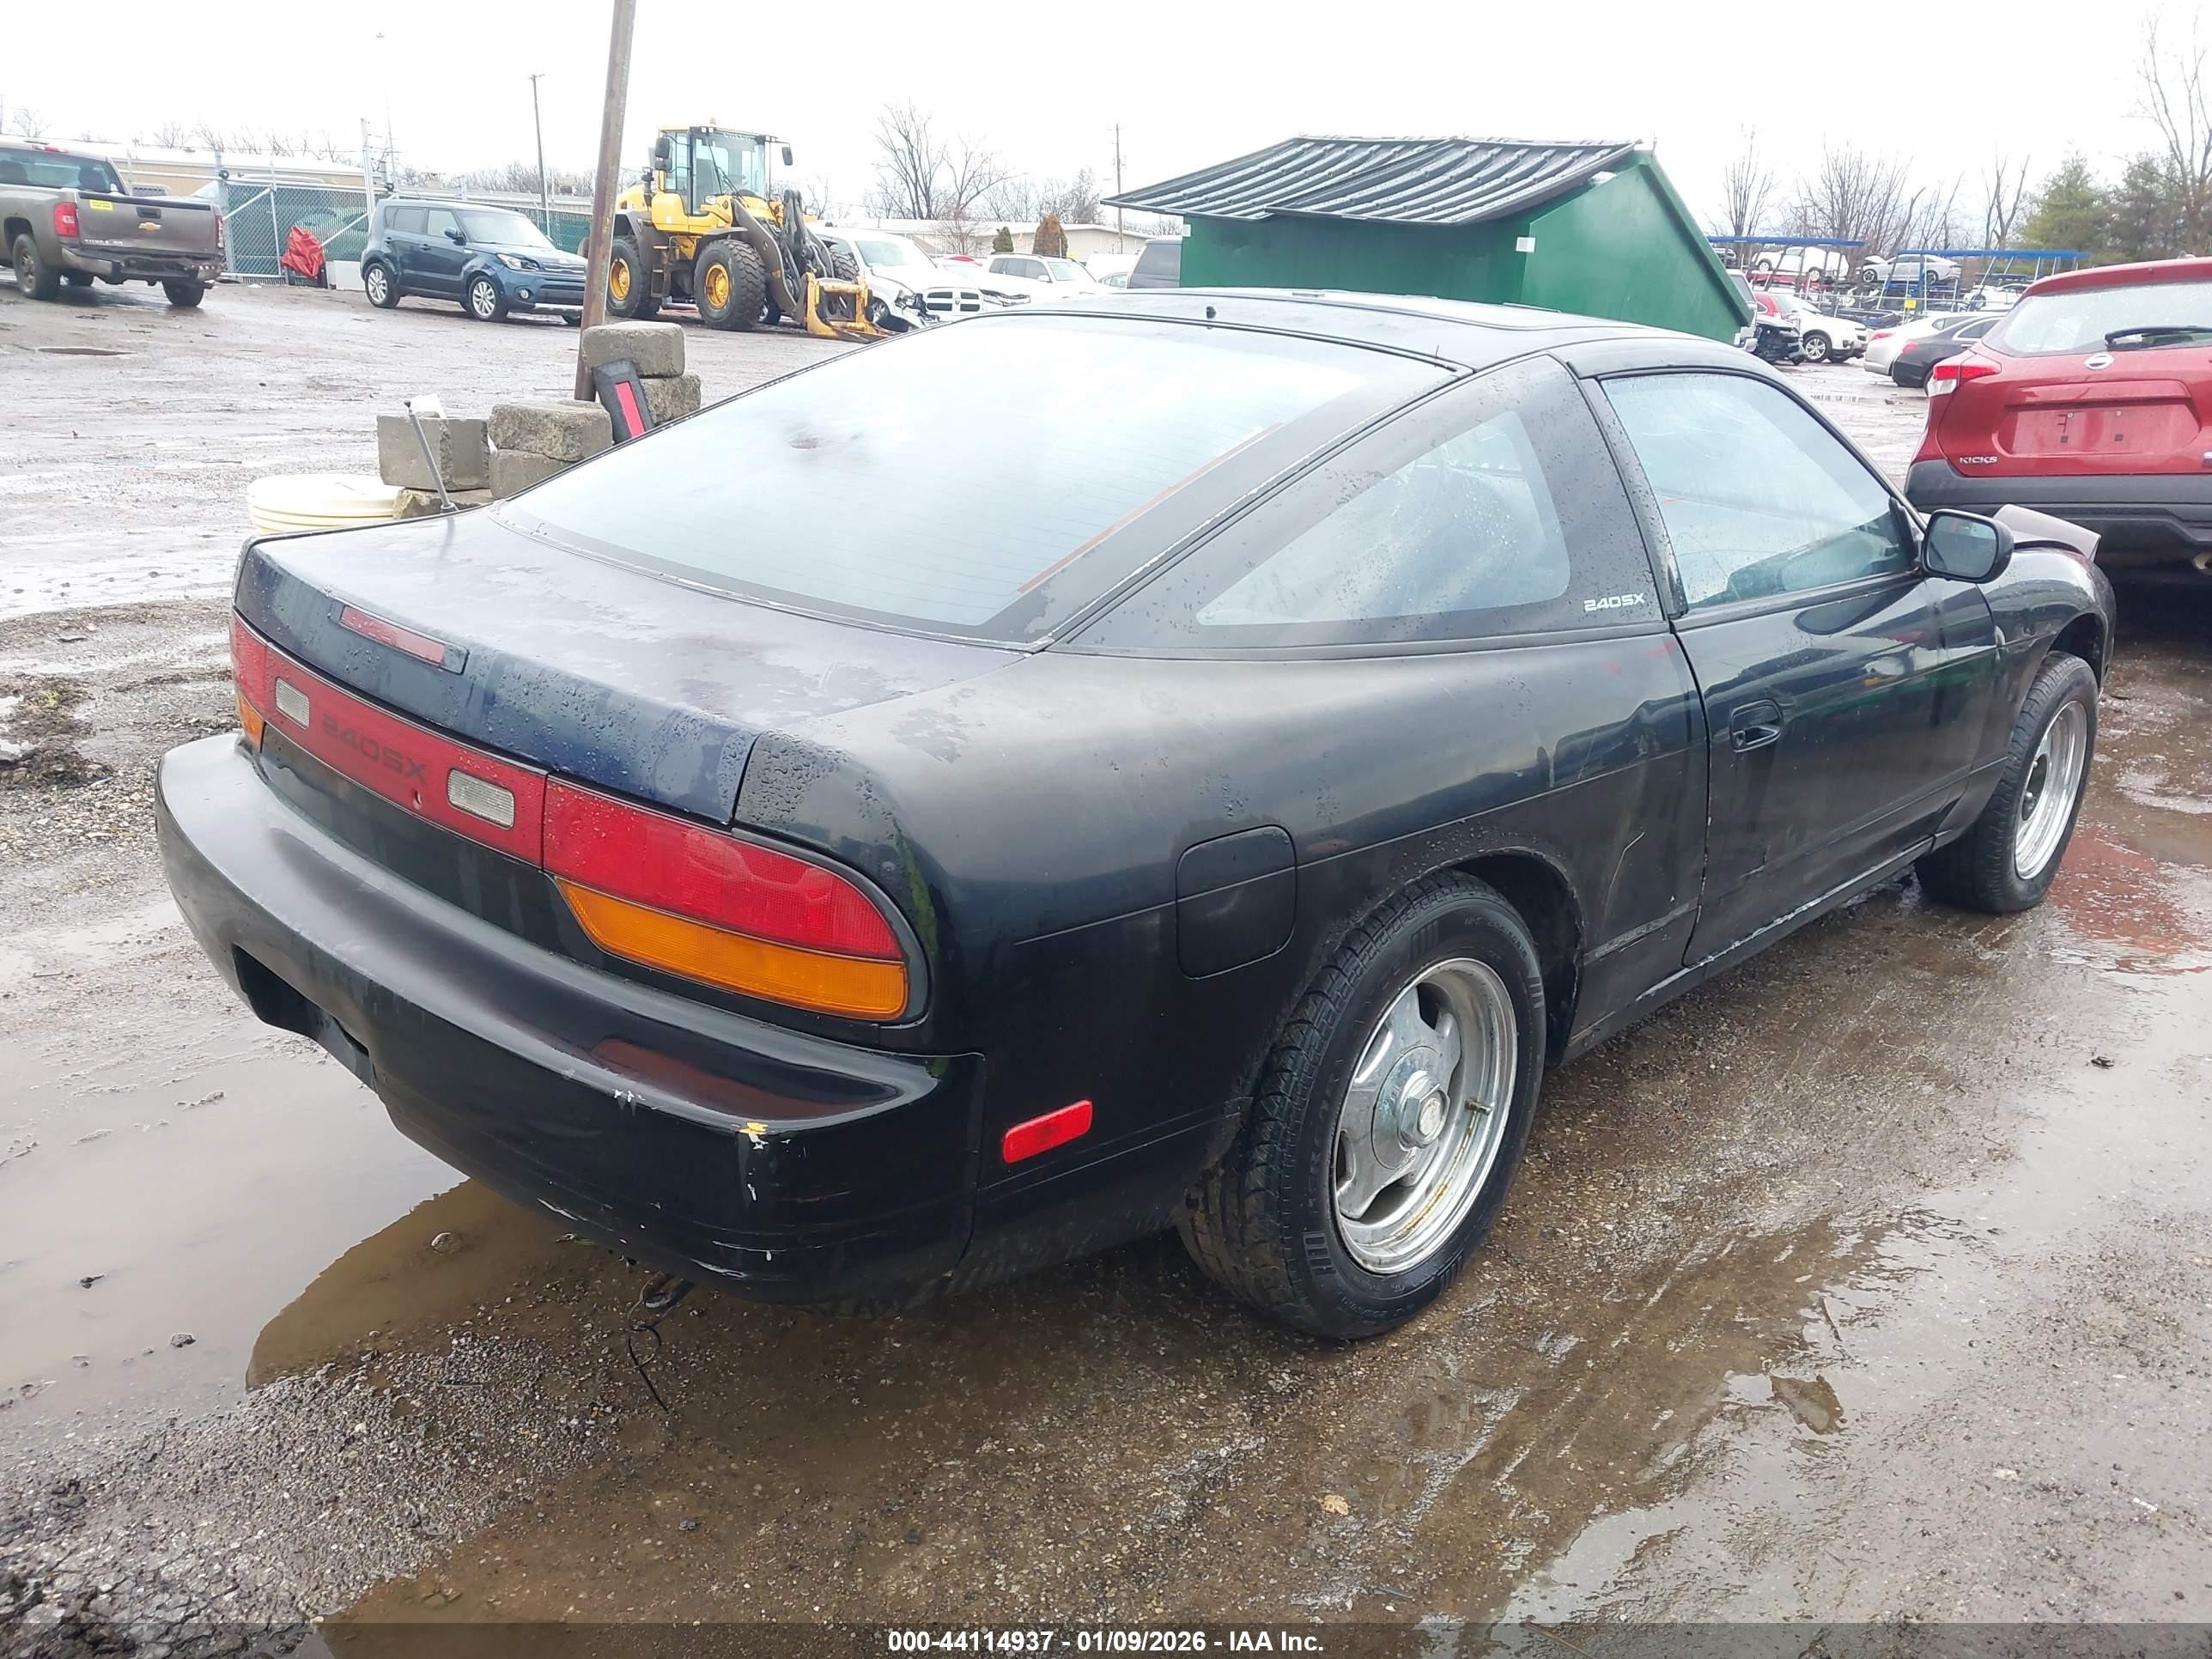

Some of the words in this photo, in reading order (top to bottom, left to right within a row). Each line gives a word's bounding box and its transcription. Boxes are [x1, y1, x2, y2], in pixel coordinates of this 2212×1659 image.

[1959, 456, 1998, 465] KICKS
[1583, 592, 1645, 612] 240SX
[322, 714, 428, 785] 240SX
